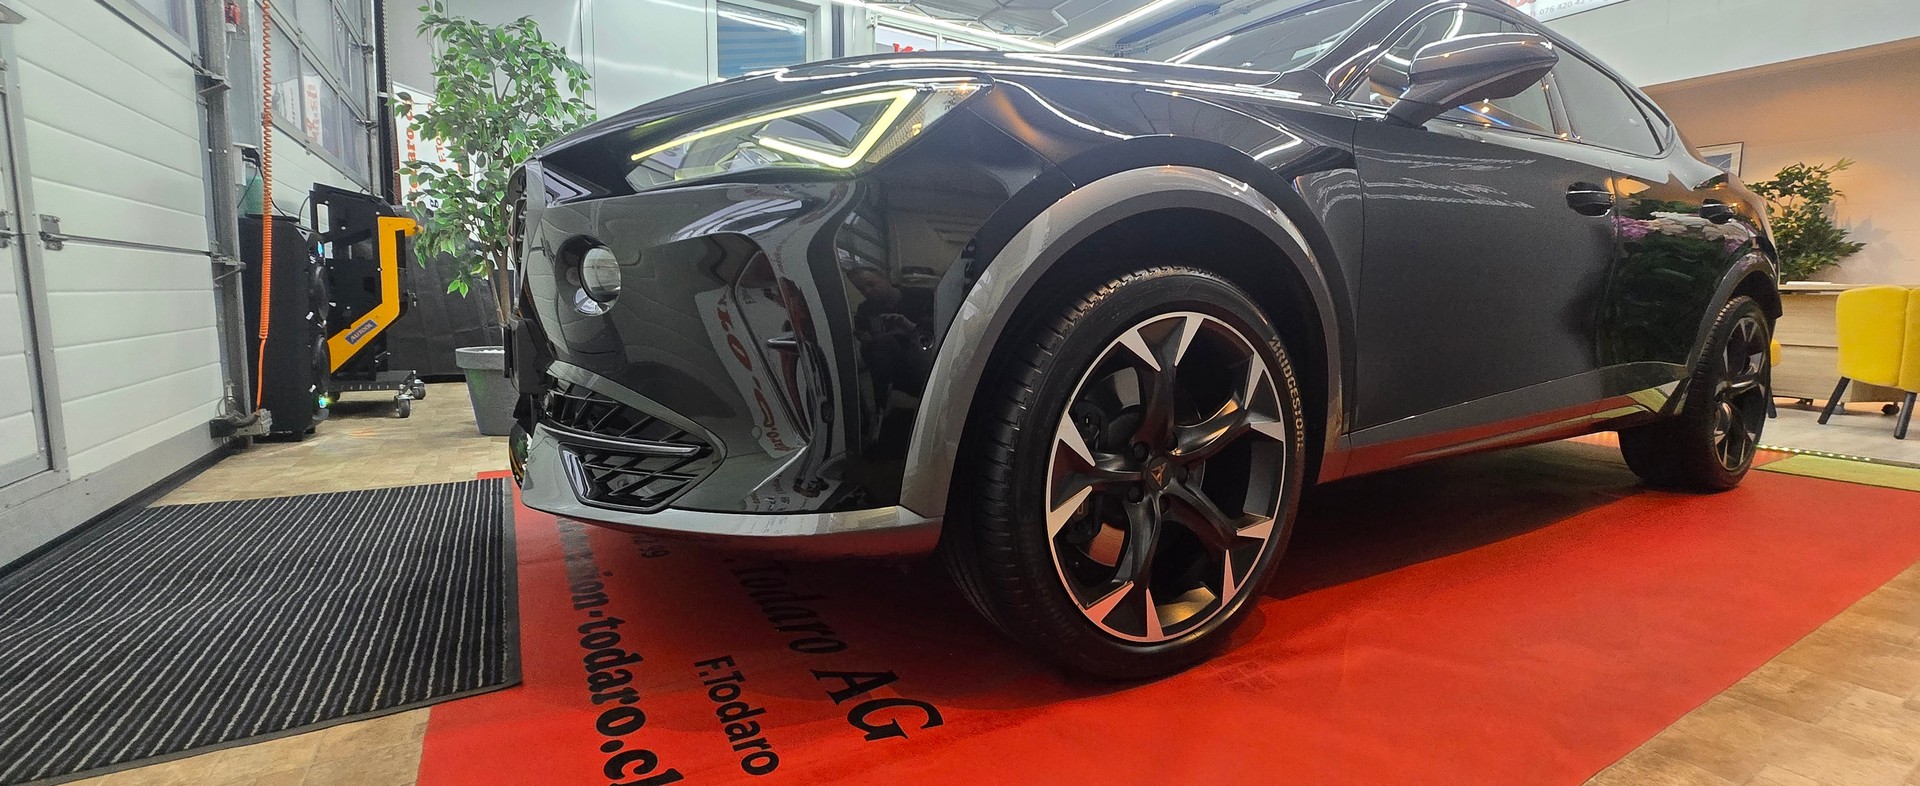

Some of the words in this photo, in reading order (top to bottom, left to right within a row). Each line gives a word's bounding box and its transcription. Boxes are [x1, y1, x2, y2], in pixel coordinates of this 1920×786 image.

[1539, 6, 1555, 16] 076
[1268, 335, 1305, 452] BRIDGESTONE
[693, 654, 780, 776] F.Todaro
[809, 668, 944, 742] AG
